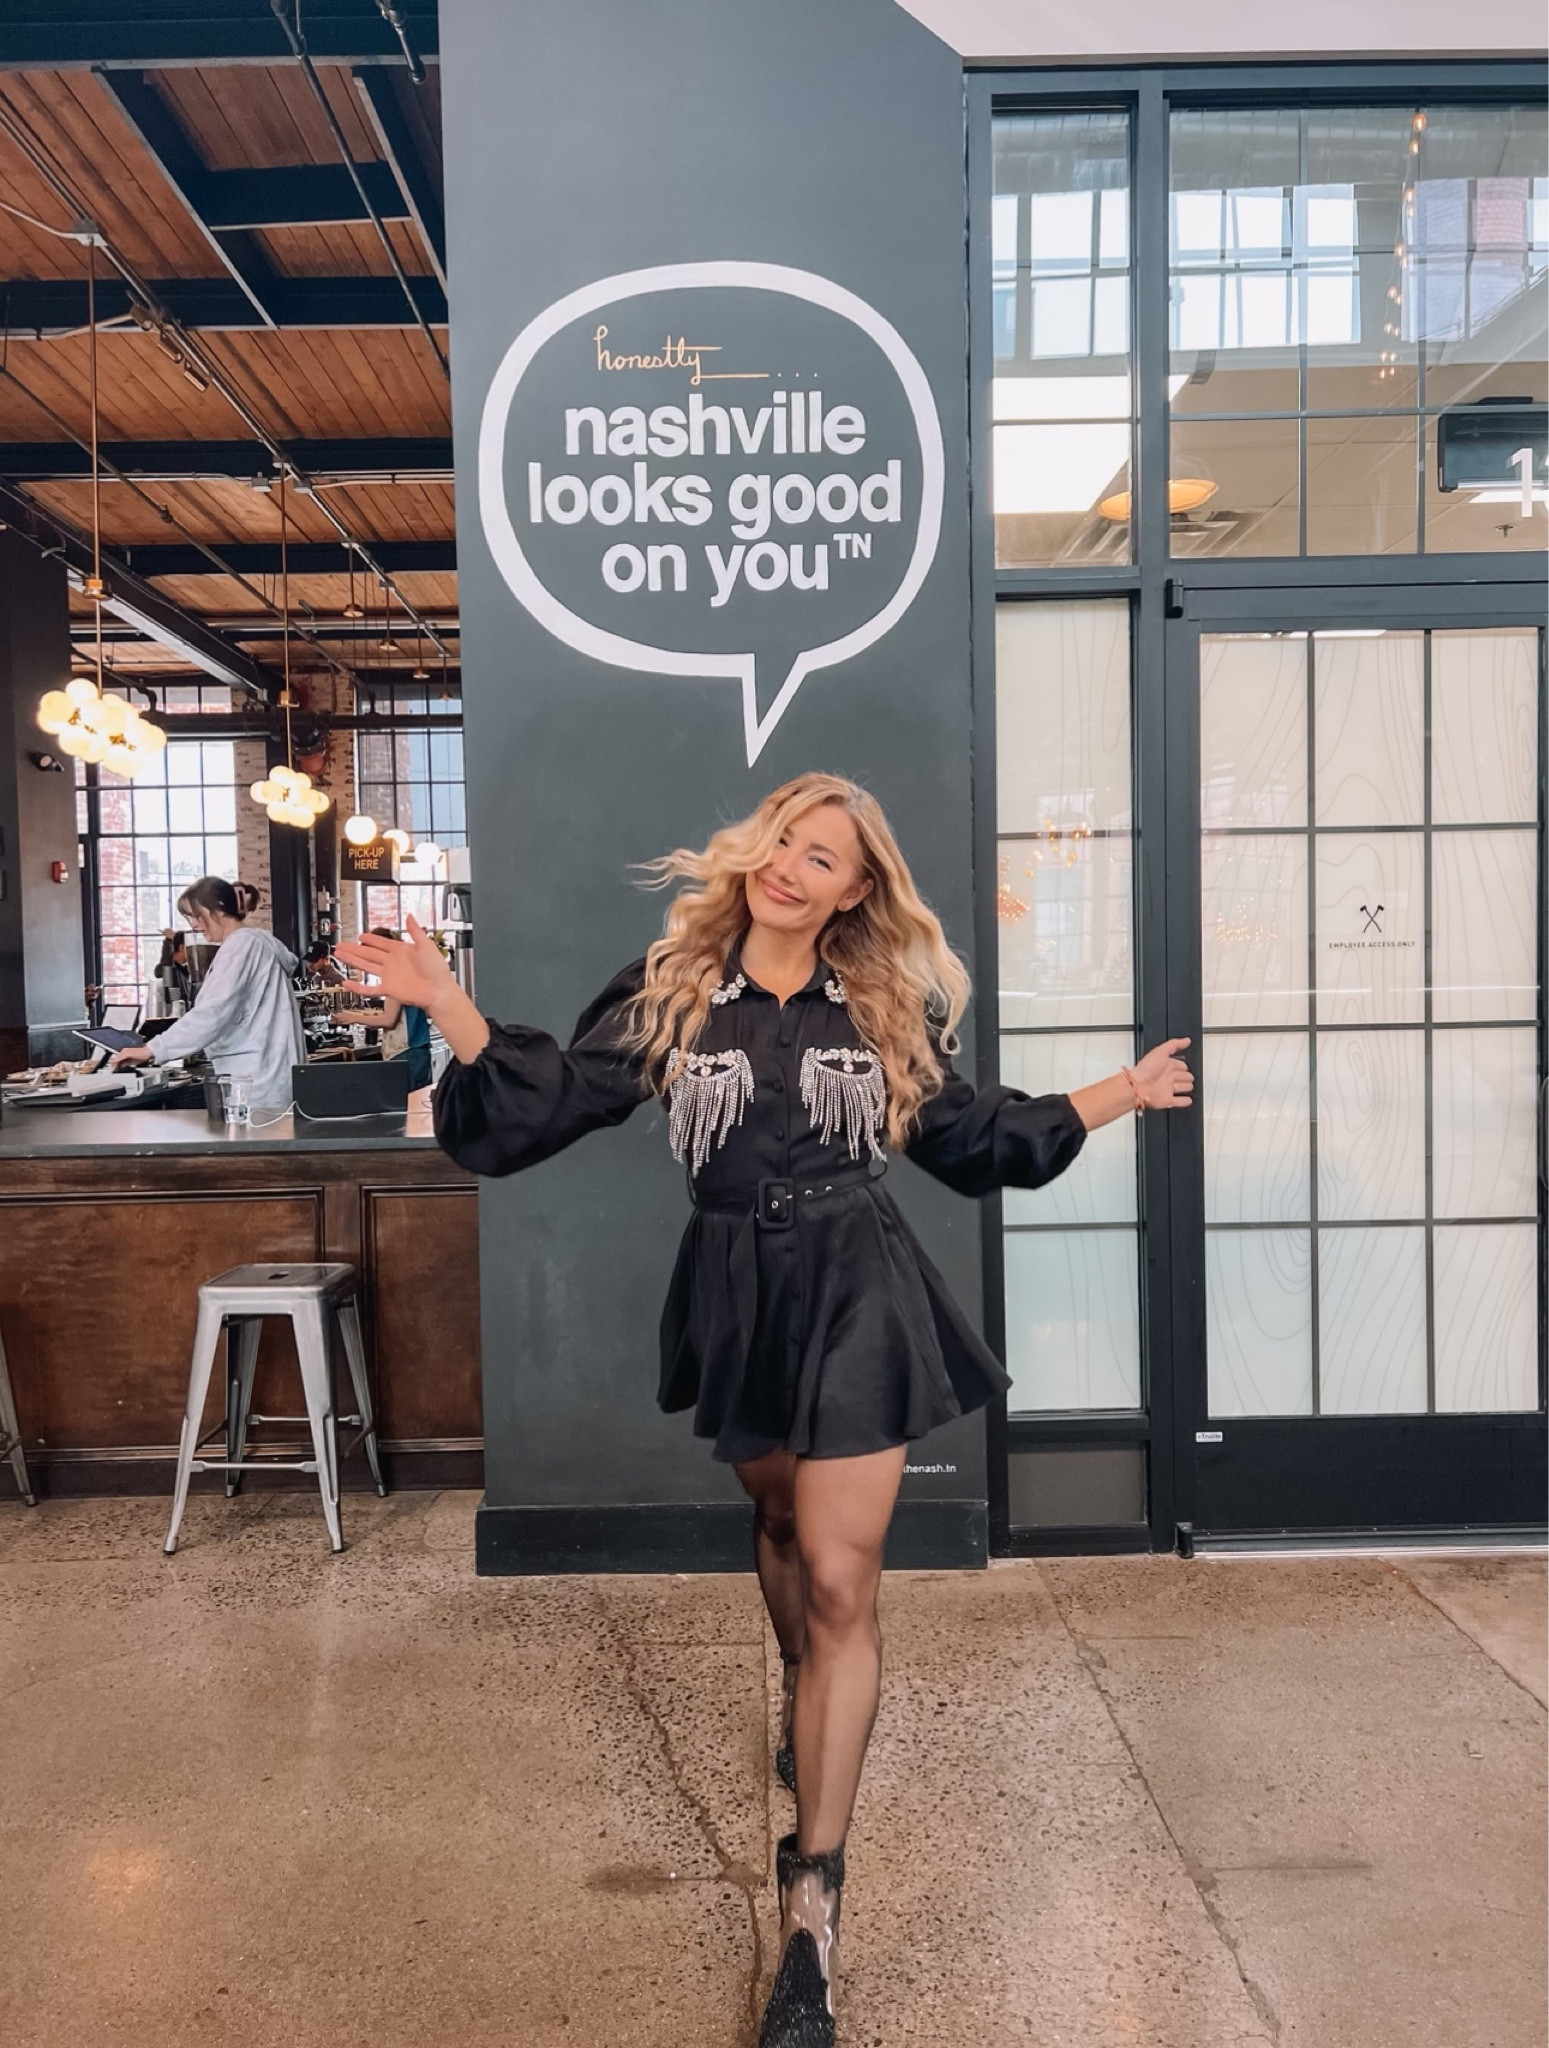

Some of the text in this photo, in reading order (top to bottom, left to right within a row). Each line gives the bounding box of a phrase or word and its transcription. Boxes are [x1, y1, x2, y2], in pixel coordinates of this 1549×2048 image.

[564, 390, 867, 458] nashville
[528, 459, 902, 540] looks good
[1510, 447, 1548, 518] 1
[602, 542, 688, 594] on
[348, 846, 385, 859] PICK-UP
[354, 858, 379, 870] HERE
[1328, 941, 1366, 949] EMPLOYEE
